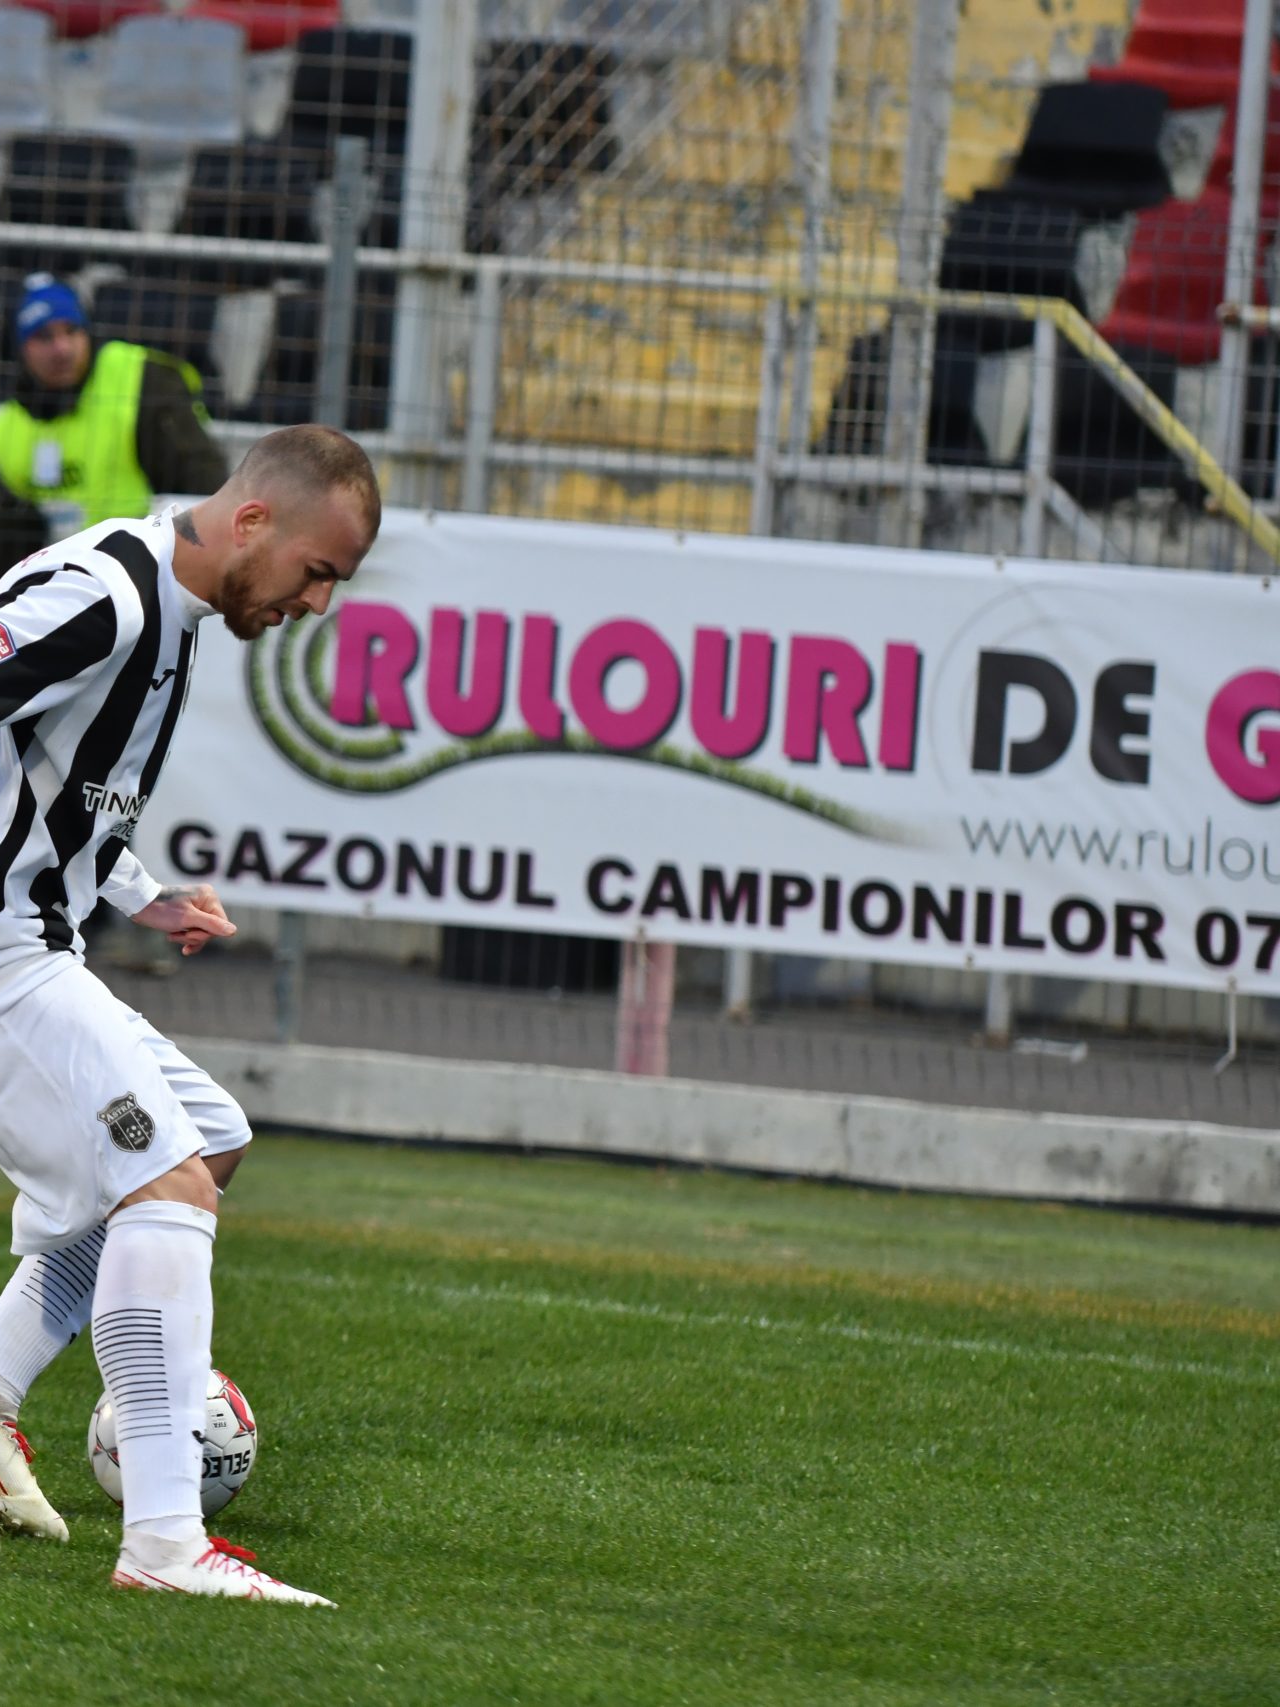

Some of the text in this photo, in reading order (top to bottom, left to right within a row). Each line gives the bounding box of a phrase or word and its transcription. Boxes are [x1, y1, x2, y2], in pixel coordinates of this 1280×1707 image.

[328, 598, 922, 773] RULOURI
[970, 647, 1157, 788] DE
[166, 821, 1280, 974] GAZONUL CAMPIONILOR 07
[106, 1100, 135, 1122] ASTRA
